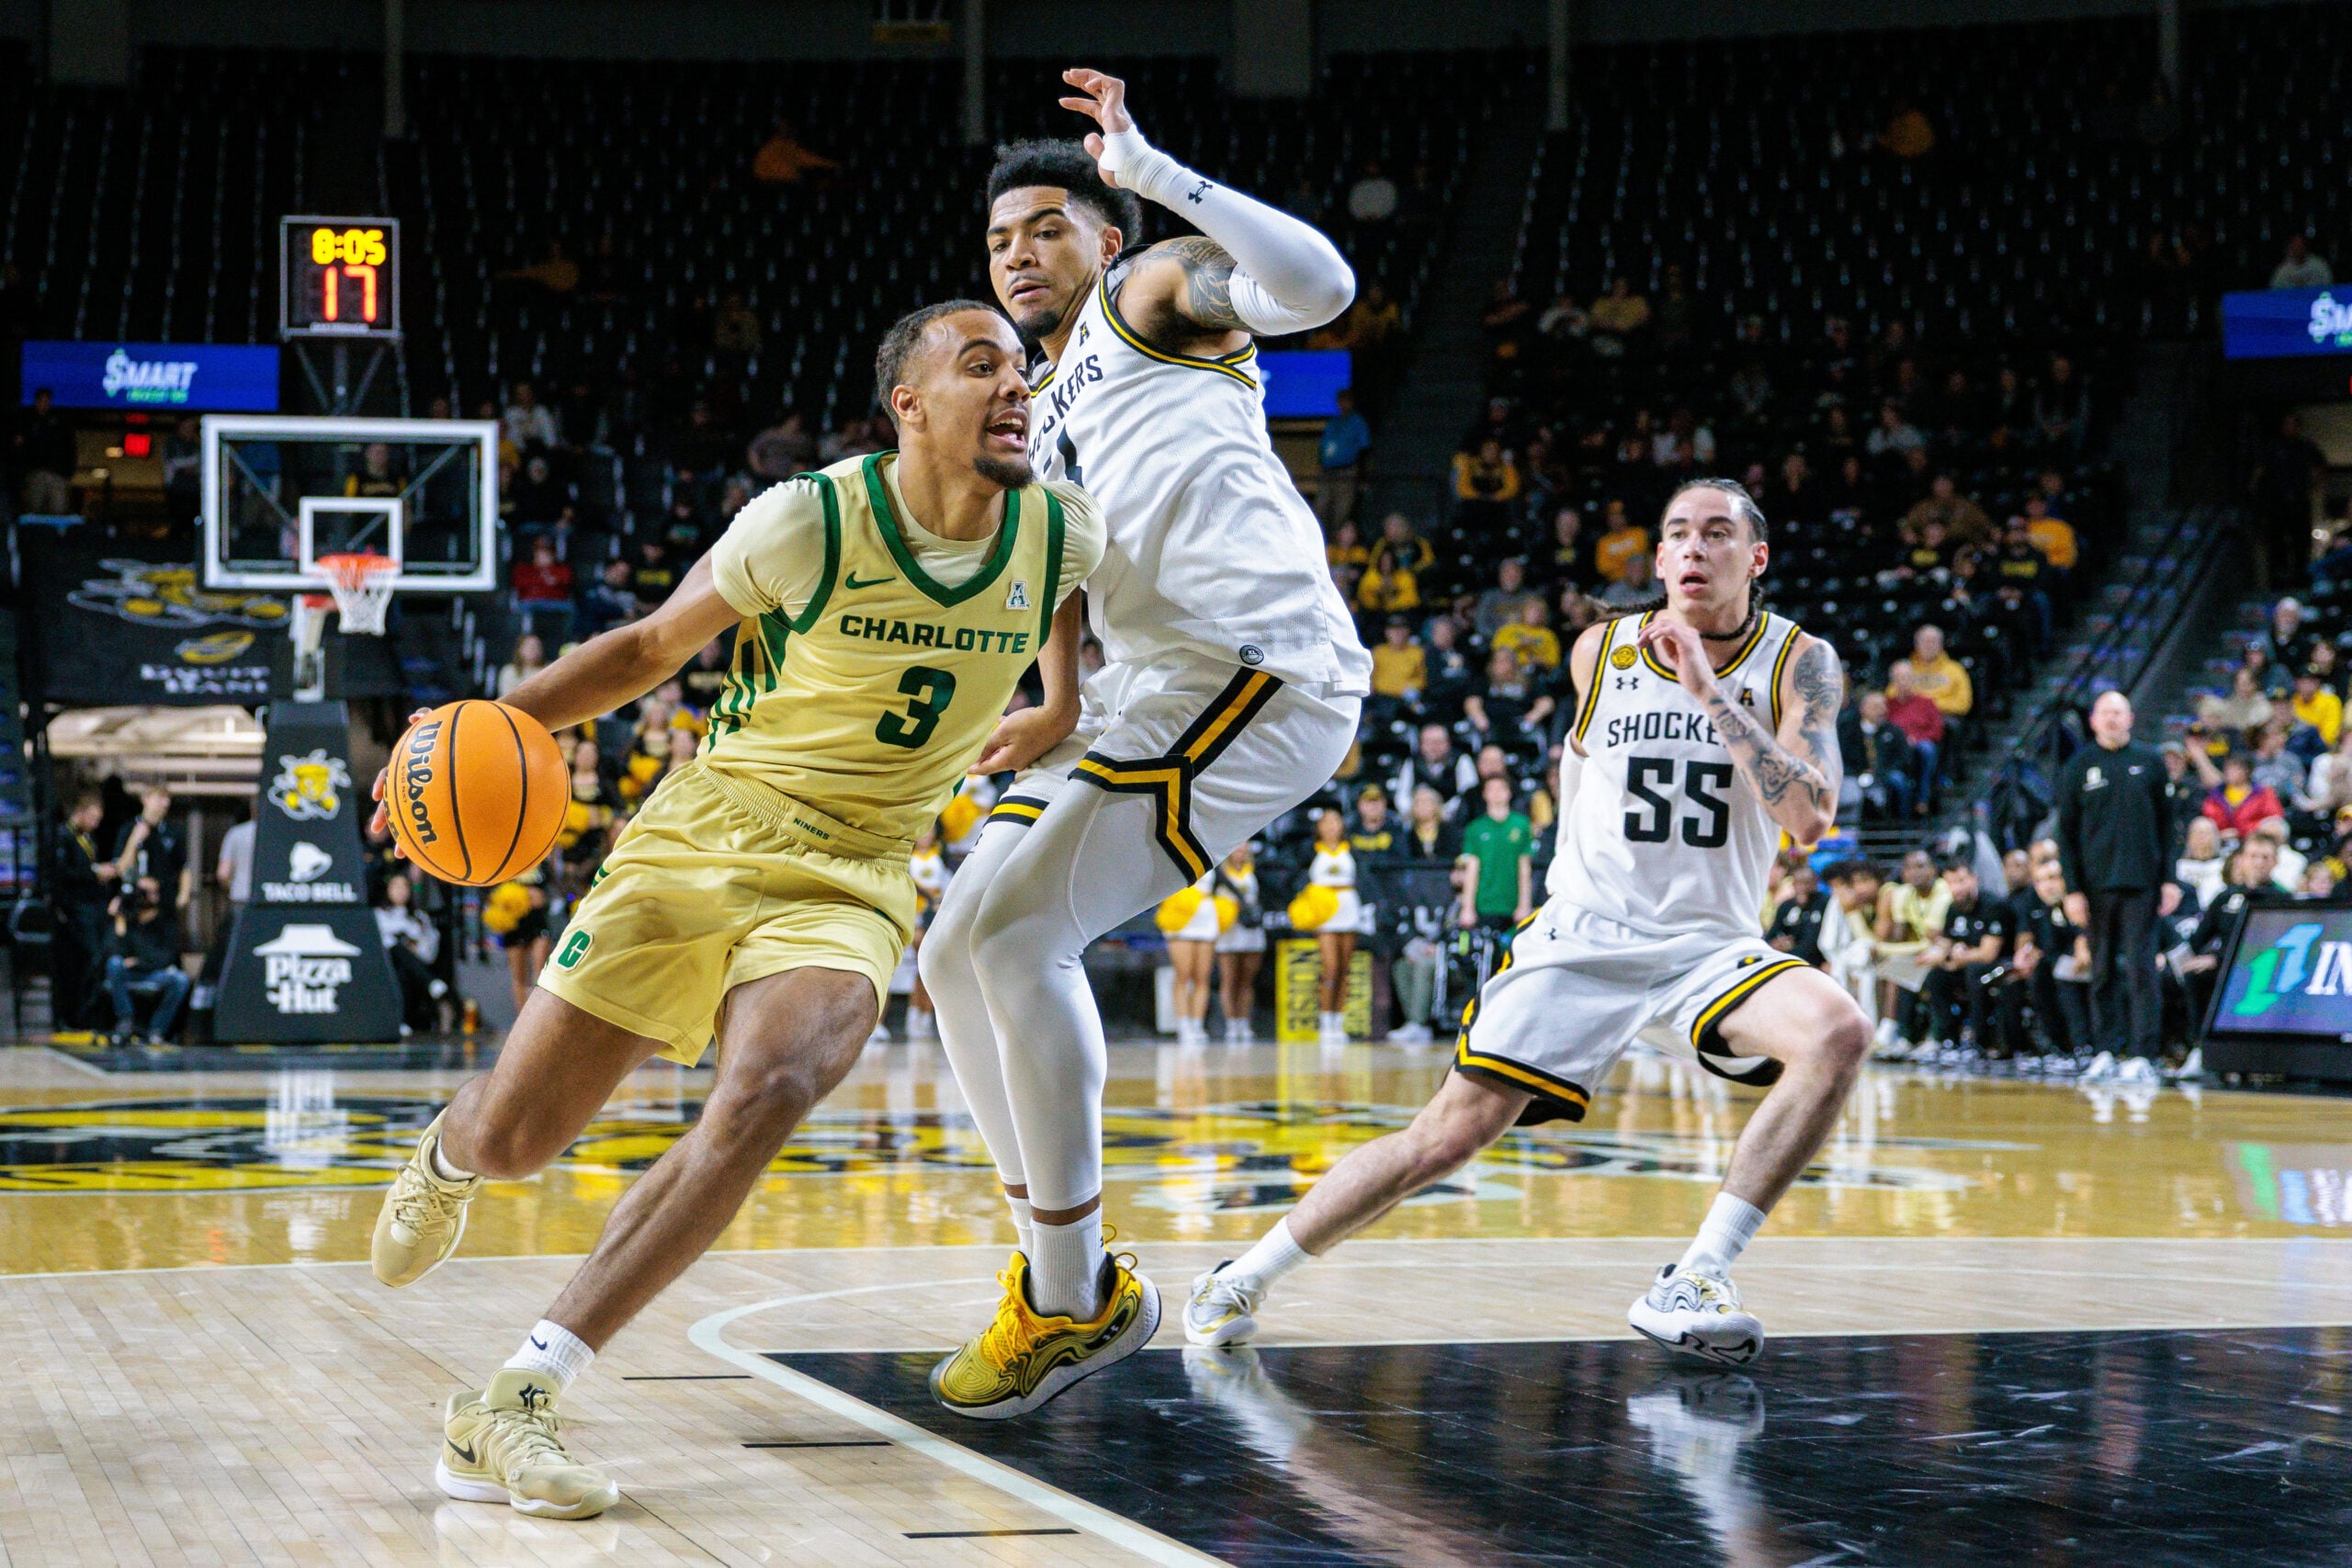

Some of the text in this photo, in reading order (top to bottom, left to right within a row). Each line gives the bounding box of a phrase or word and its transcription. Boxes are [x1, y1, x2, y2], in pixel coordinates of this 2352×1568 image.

[312, 229, 386, 265] 8:05
[323, 265, 377, 322] 17
[840, 615, 1029, 654] CHARLOTTE
[875, 665, 956, 749] 3
[1607, 711, 1726, 749] SHOCKE
[407, 721, 443, 845] Wilson
[1624, 756, 1734, 849] 55
[793, 818, 831, 840] NINERS
[262, 882, 358, 902] TACO BELL
[266, 953, 353, 988] Pizza
[266, 980, 340, 1014] Hut
